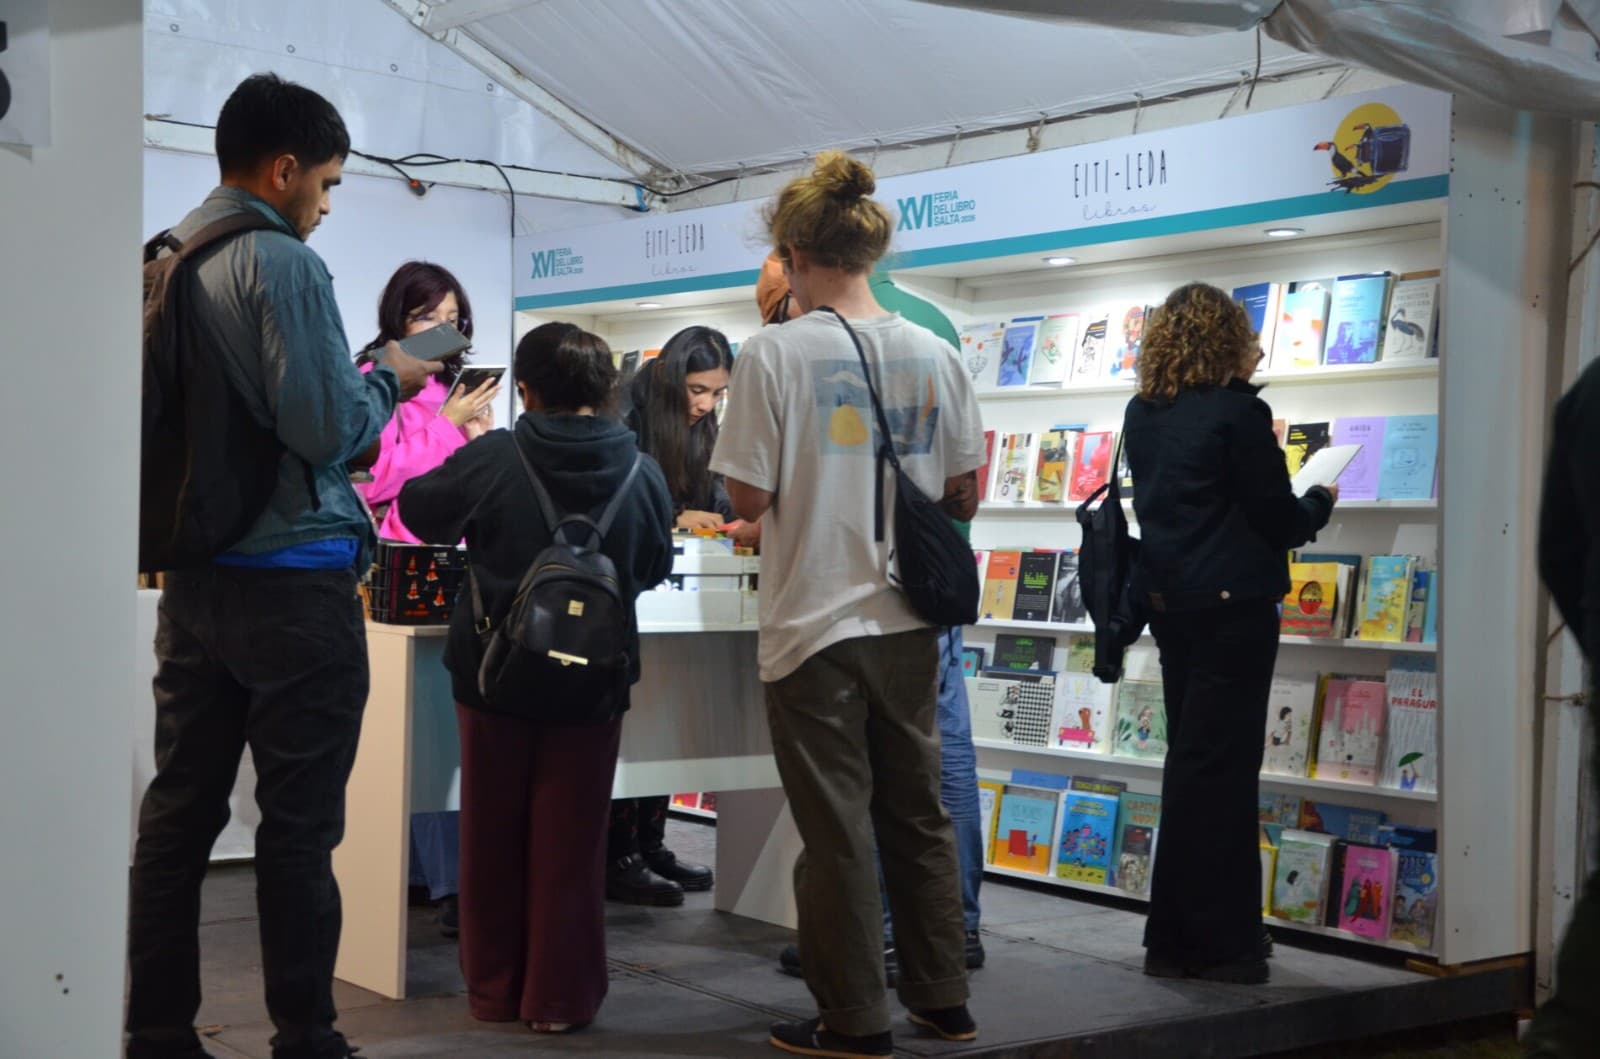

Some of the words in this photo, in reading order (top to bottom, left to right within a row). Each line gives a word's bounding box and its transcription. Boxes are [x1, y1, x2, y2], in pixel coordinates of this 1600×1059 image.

[934, 190, 958, 203] FERIA
[897, 194, 932, 232] XVI
[934, 204, 950, 215] DEL
[950, 200, 976, 213] LIBRO
[934, 214, 960, 226] SALTA
[531, 249, 555, 279] XVI
